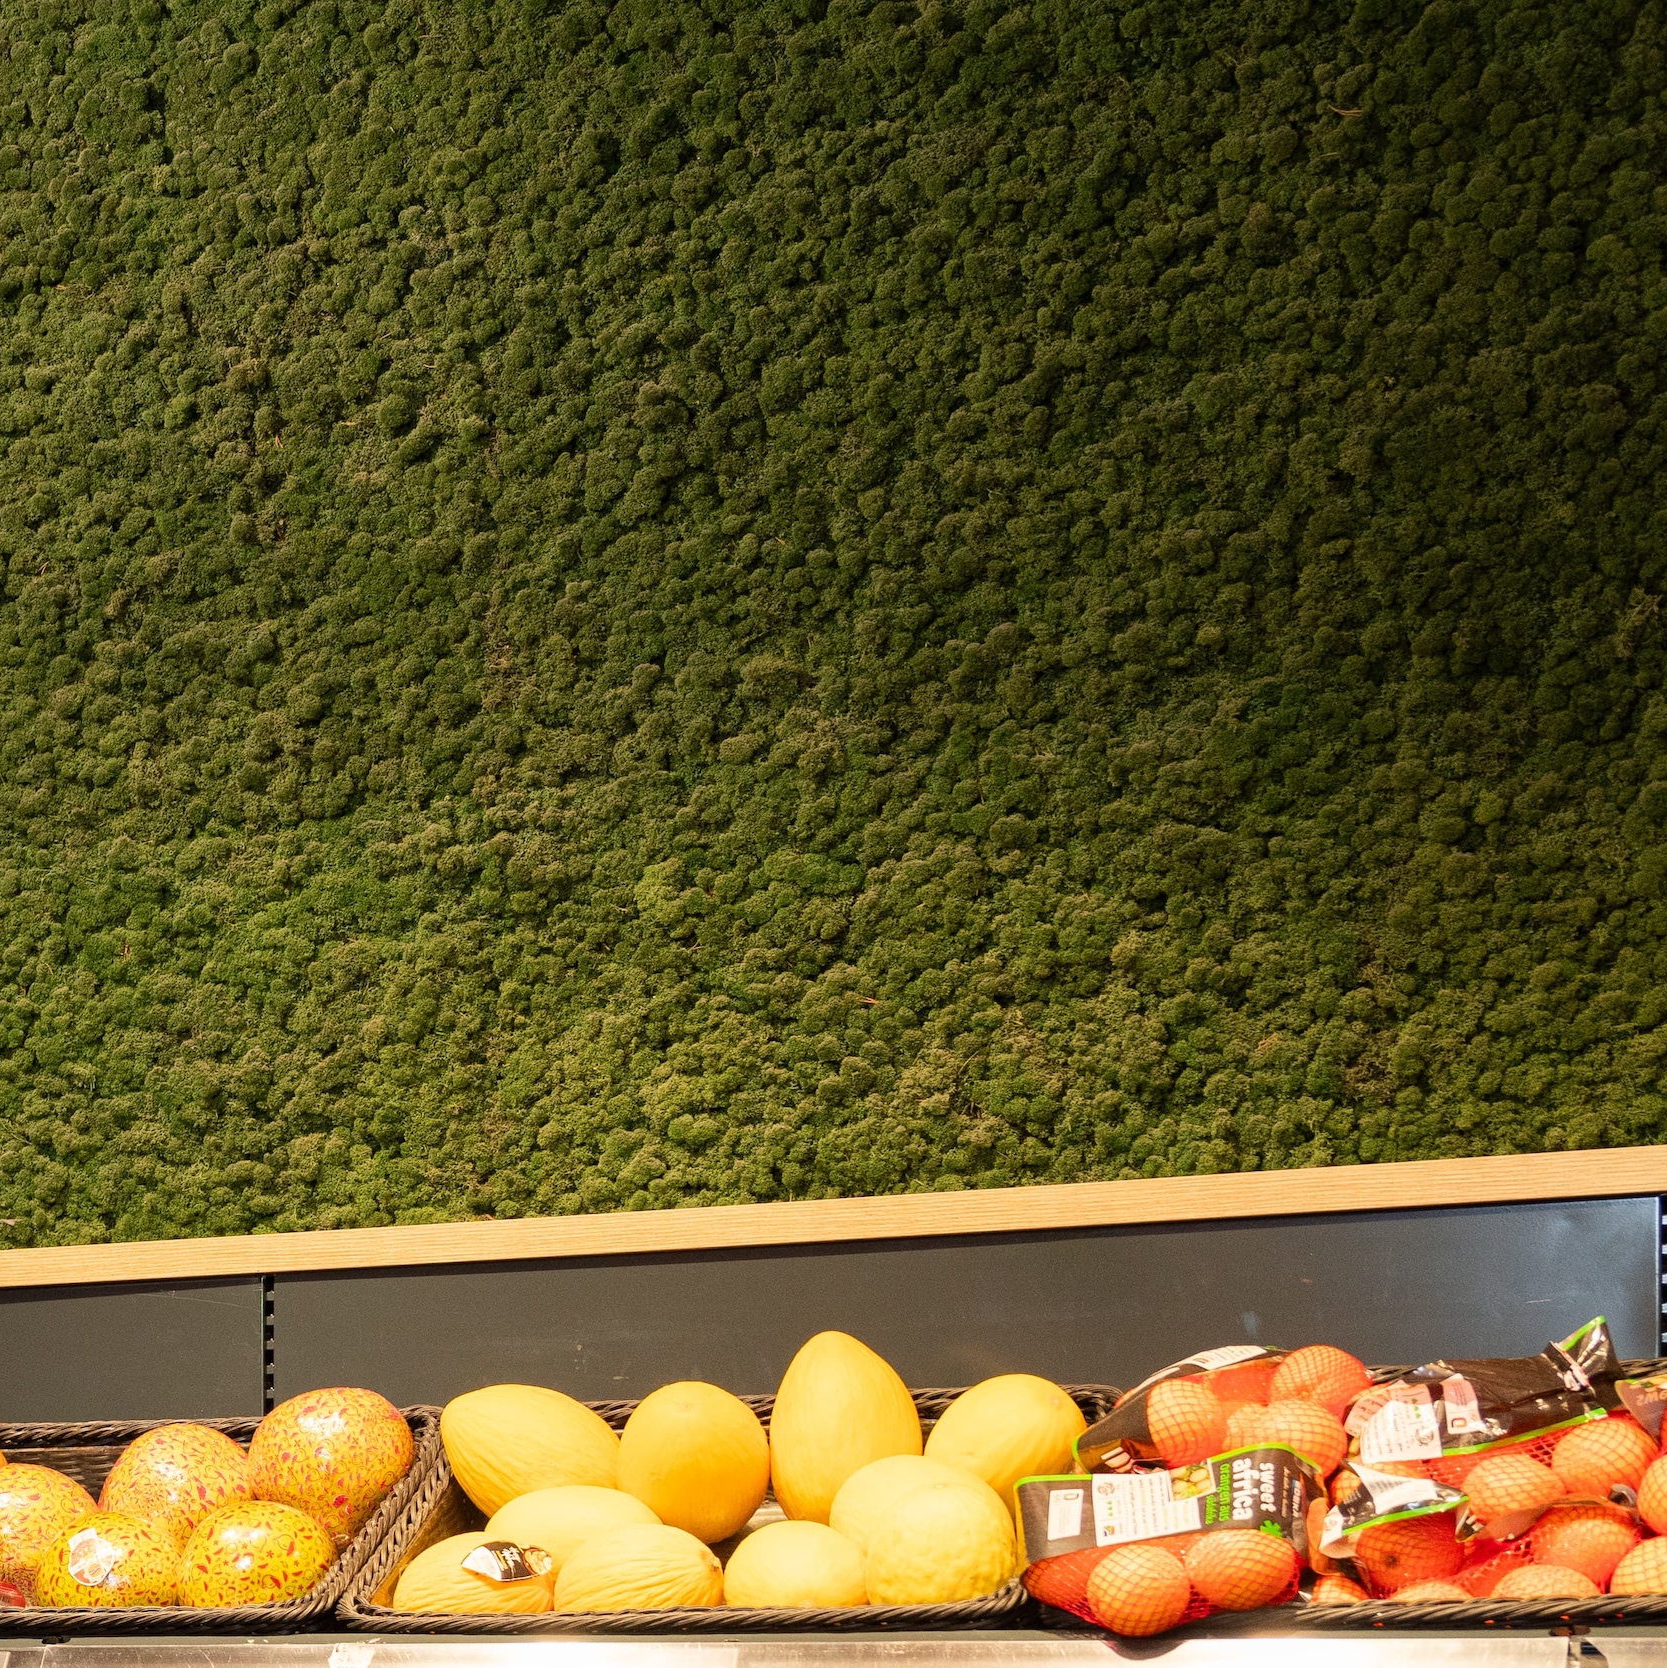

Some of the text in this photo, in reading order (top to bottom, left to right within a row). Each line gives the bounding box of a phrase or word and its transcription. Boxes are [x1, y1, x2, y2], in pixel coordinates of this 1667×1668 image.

[1217, 1463, 1230, 1523] orangen aus
[1232, 1457, 1254, 1521] africa
[1258, 1462, 1276, 1512] sweet
